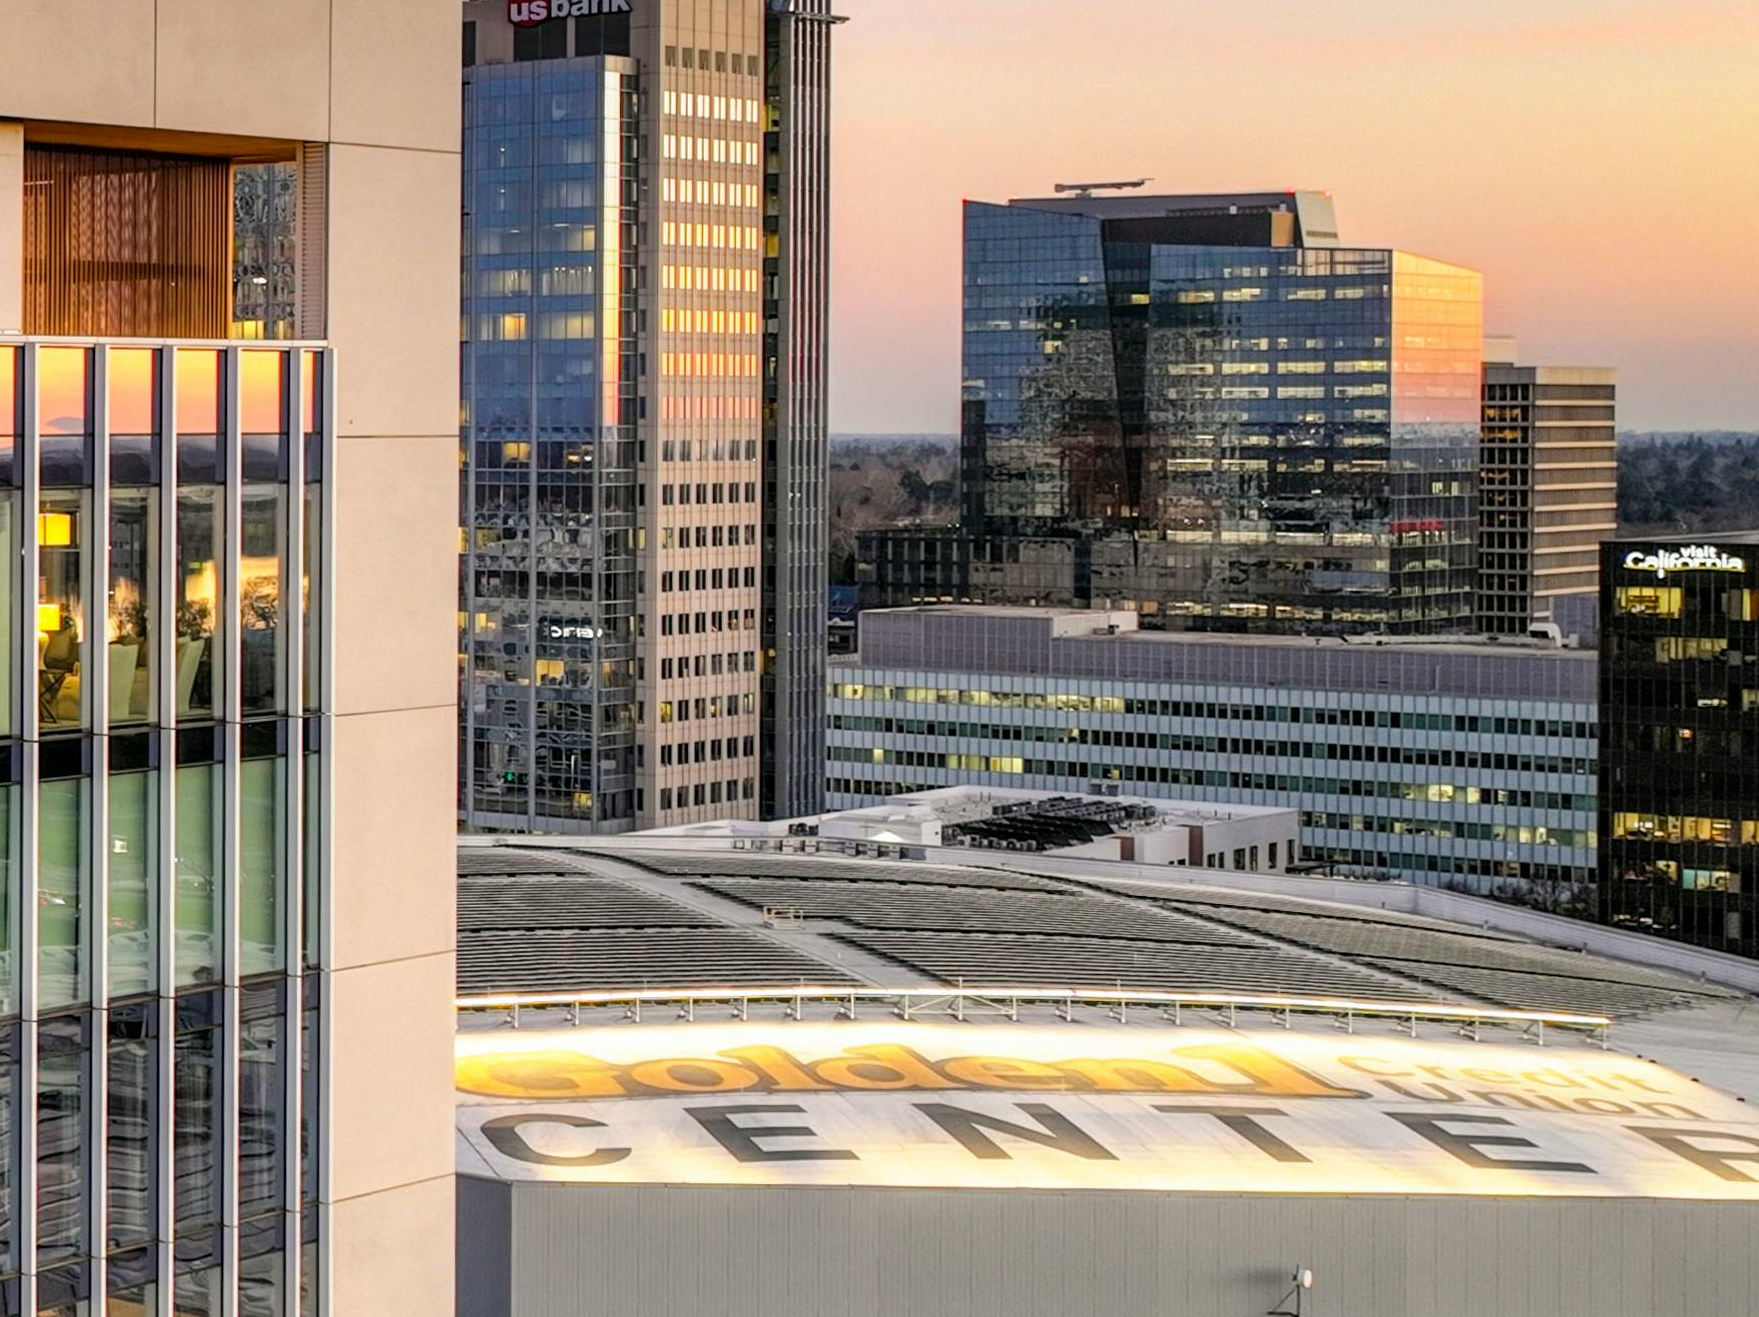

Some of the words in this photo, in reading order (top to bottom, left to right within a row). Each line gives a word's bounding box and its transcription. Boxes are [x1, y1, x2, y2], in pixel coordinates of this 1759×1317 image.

[1623, 548, 1747, 580] California
[1679, 544, 1718, 559] visit
[1336, 1053, 1675, 1096] Credit
[1372, 1077, 1714, 1121] Union
[478, 1102, 1759, 1183] CENTER
